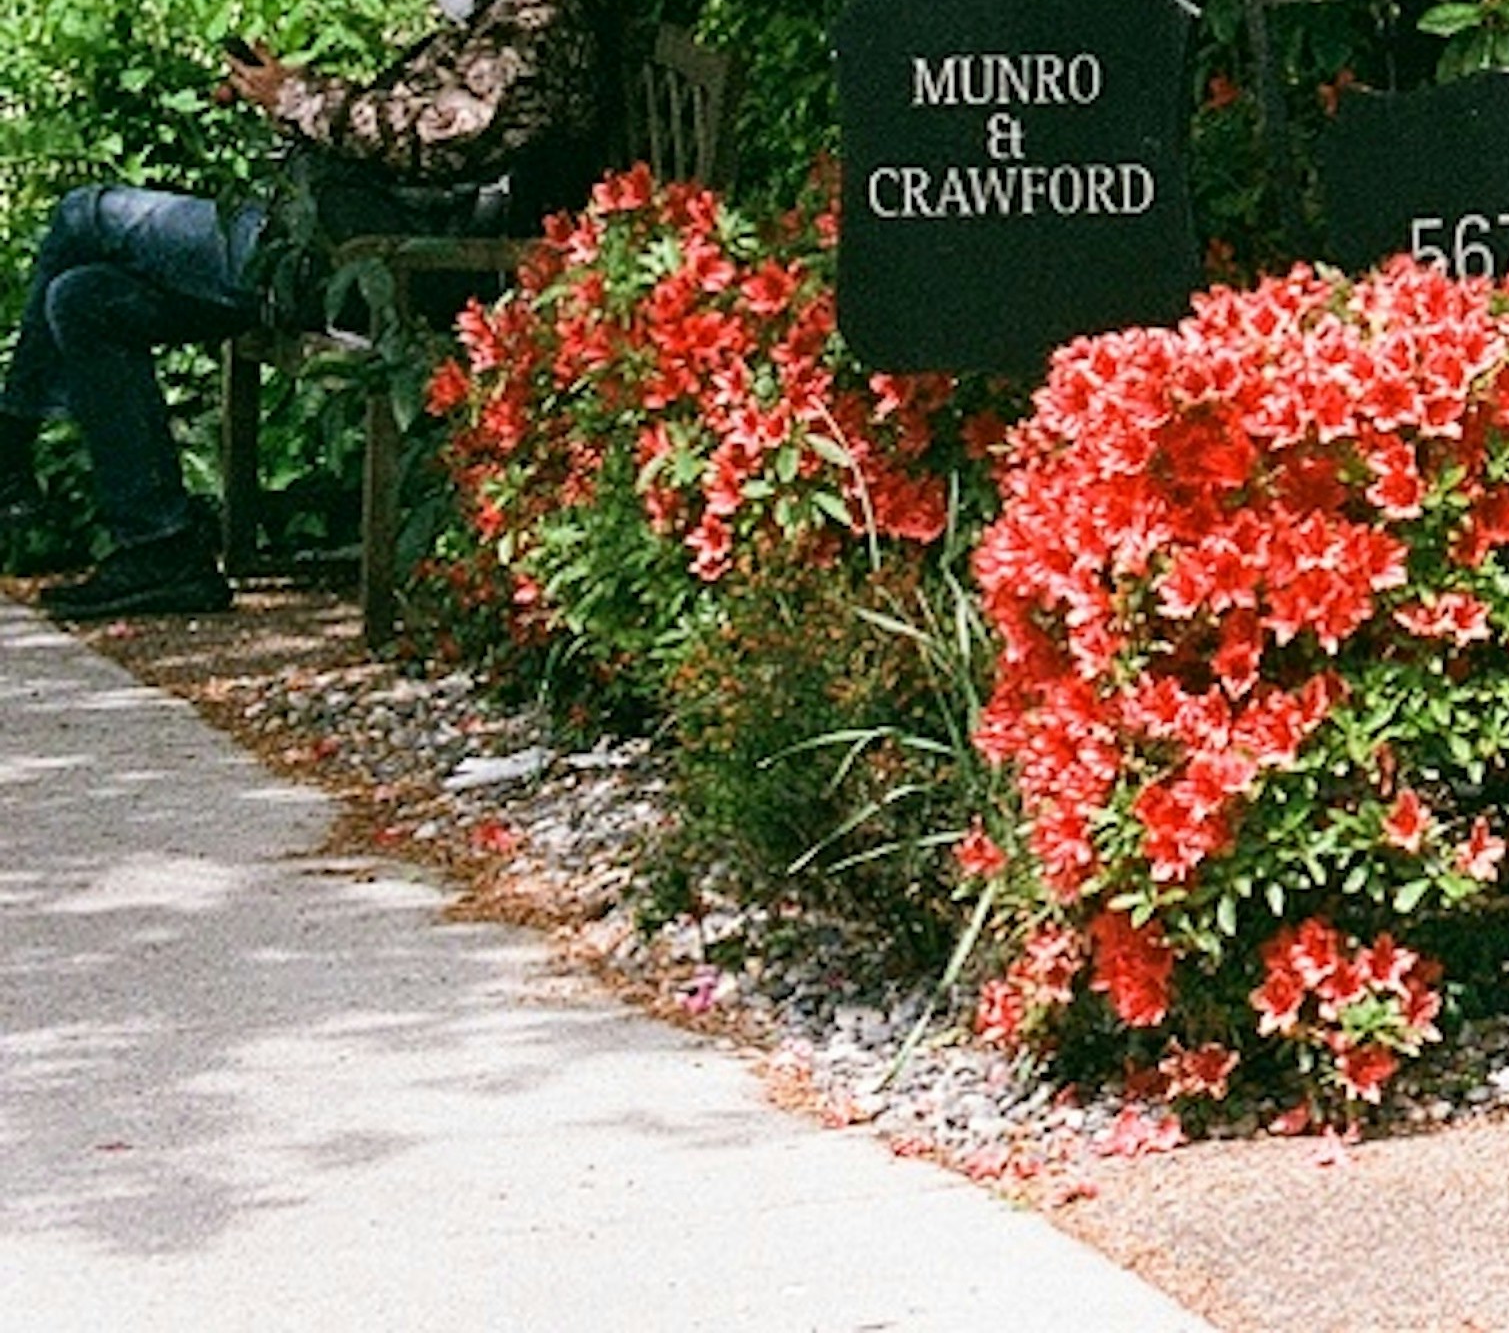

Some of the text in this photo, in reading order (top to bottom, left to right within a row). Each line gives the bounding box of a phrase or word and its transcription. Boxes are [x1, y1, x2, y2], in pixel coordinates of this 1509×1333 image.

[912, 53, 1102, 106] MUNRO
[986, 112, 1026, 161] &
[868, 162, 1155, 219] CRAWFORD
